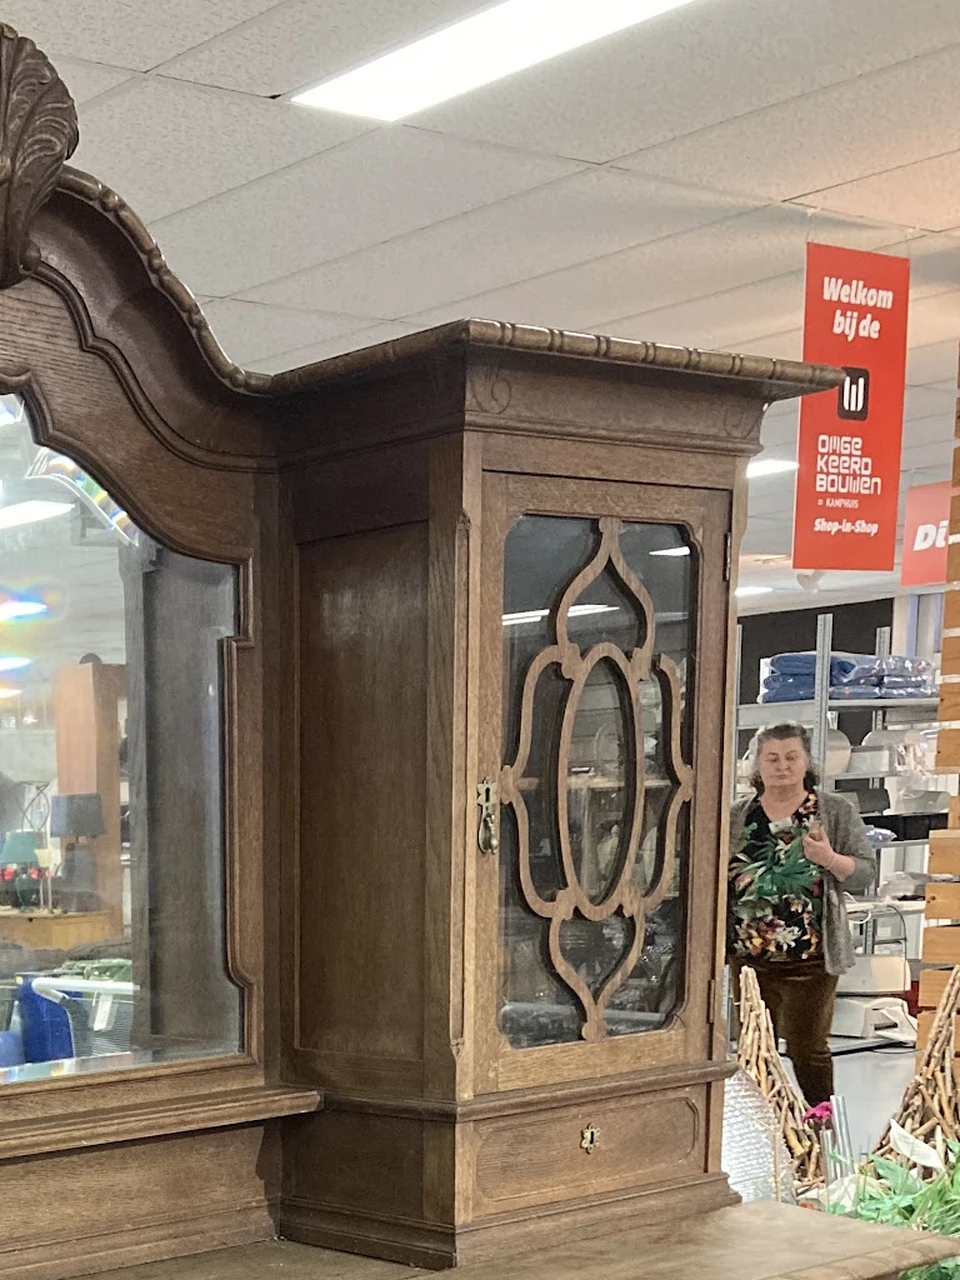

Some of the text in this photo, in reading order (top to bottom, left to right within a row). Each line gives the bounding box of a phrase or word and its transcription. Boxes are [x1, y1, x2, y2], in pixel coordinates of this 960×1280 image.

[823, 276, 893, 309] Welkom
[832, 309, 881, 342] bij de
[825, 498, 859, 508] KAMPHUIS
[813, 518, 879, 537] Shop-in-Shop
